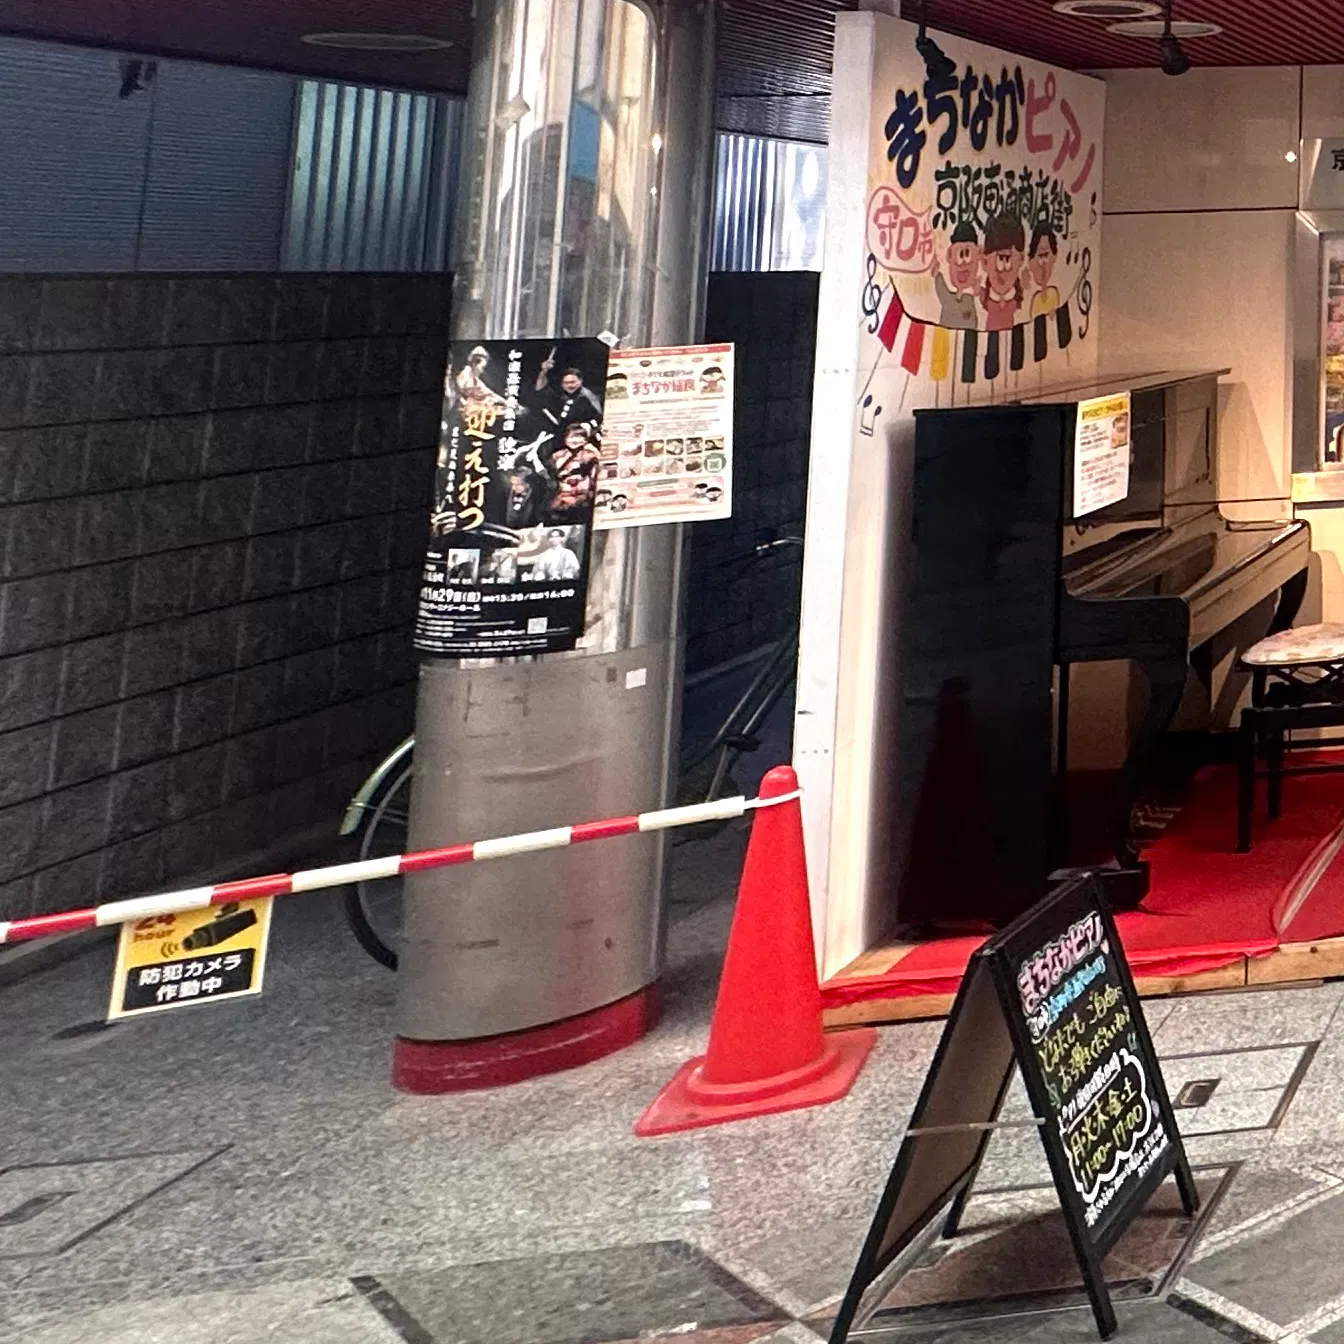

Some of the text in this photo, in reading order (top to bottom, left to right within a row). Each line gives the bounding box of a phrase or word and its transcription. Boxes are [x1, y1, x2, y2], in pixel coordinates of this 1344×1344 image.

[138, 953, 242, 986] 防犯カメラ
[155, 975, 223, 1003] 作動中
